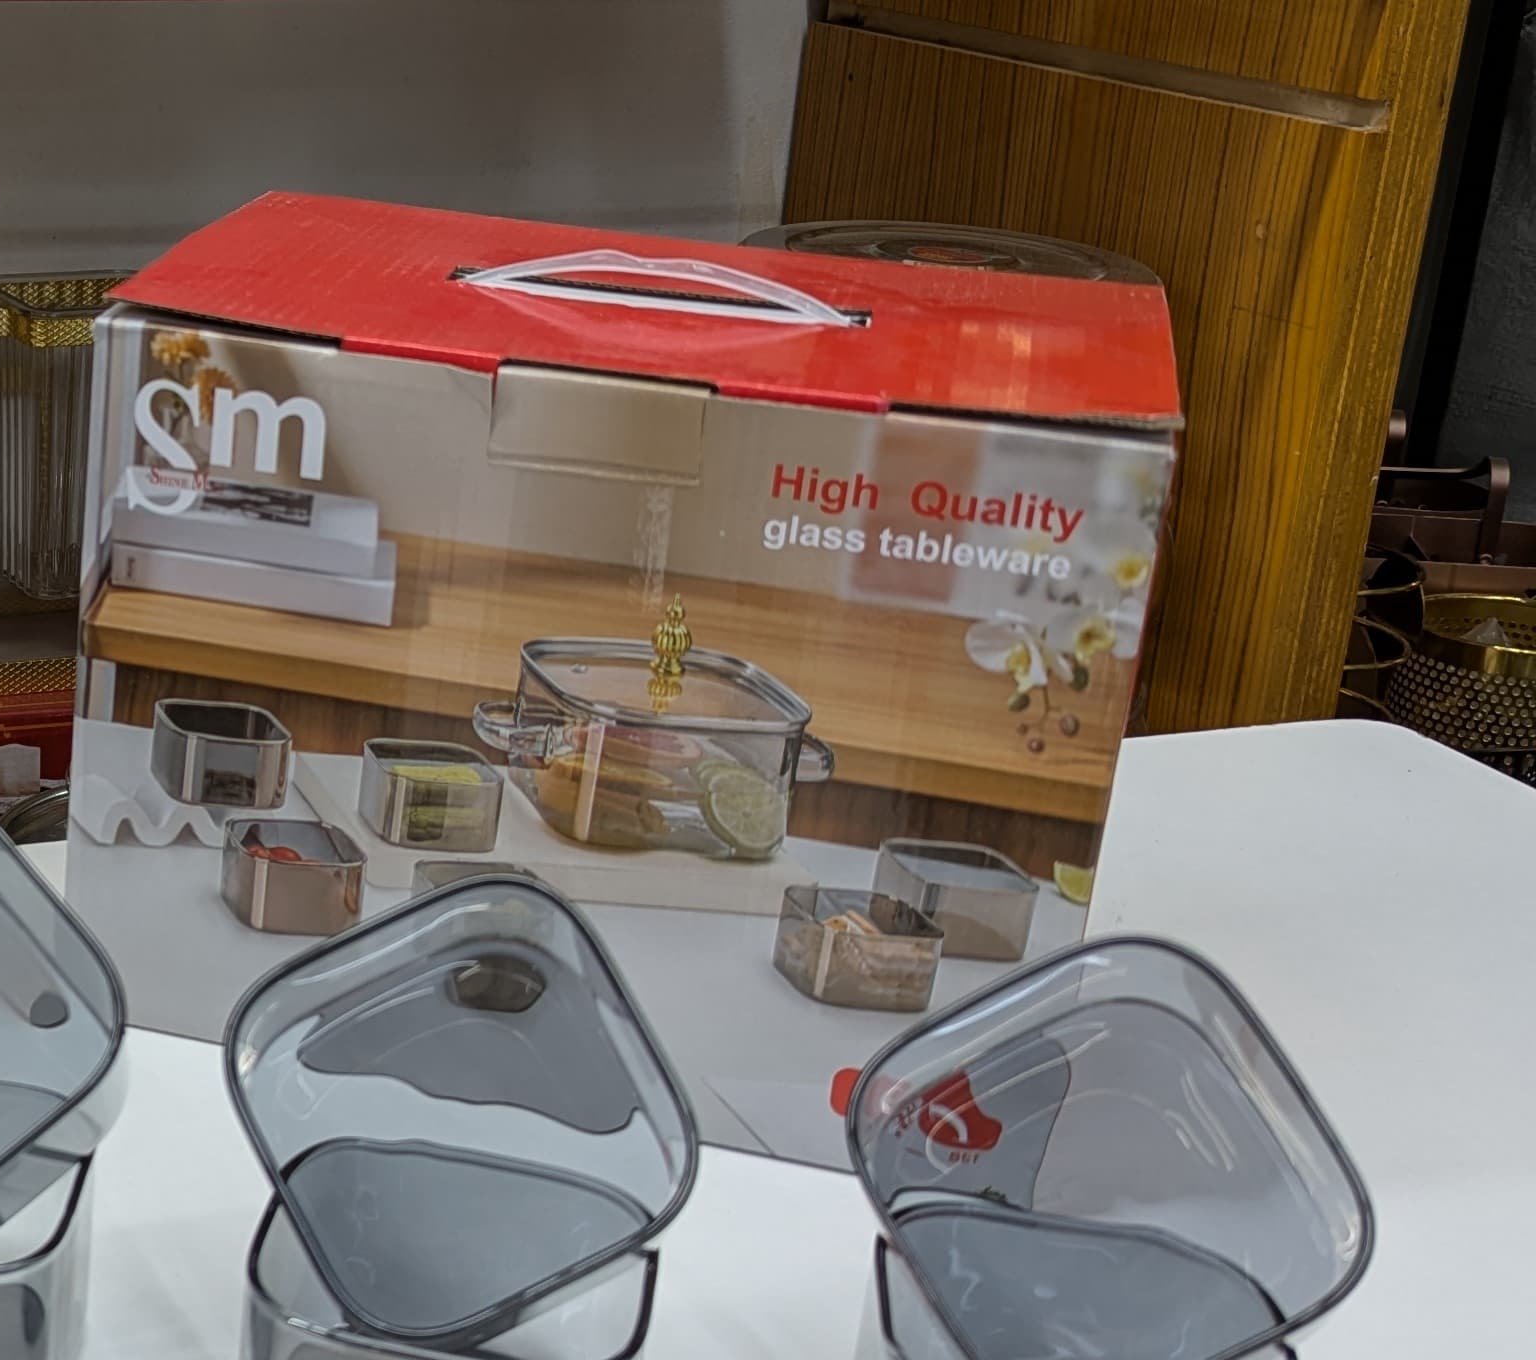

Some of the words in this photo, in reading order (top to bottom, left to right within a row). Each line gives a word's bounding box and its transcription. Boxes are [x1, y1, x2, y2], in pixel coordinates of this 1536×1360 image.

[126, 378, 326, 515] Sm
[770, 463, 880, 516] High
[910, 480, 1085, 544] Quality
[762, 514, 867, 554] glass
[878, 527, 1072, 580] tableware
